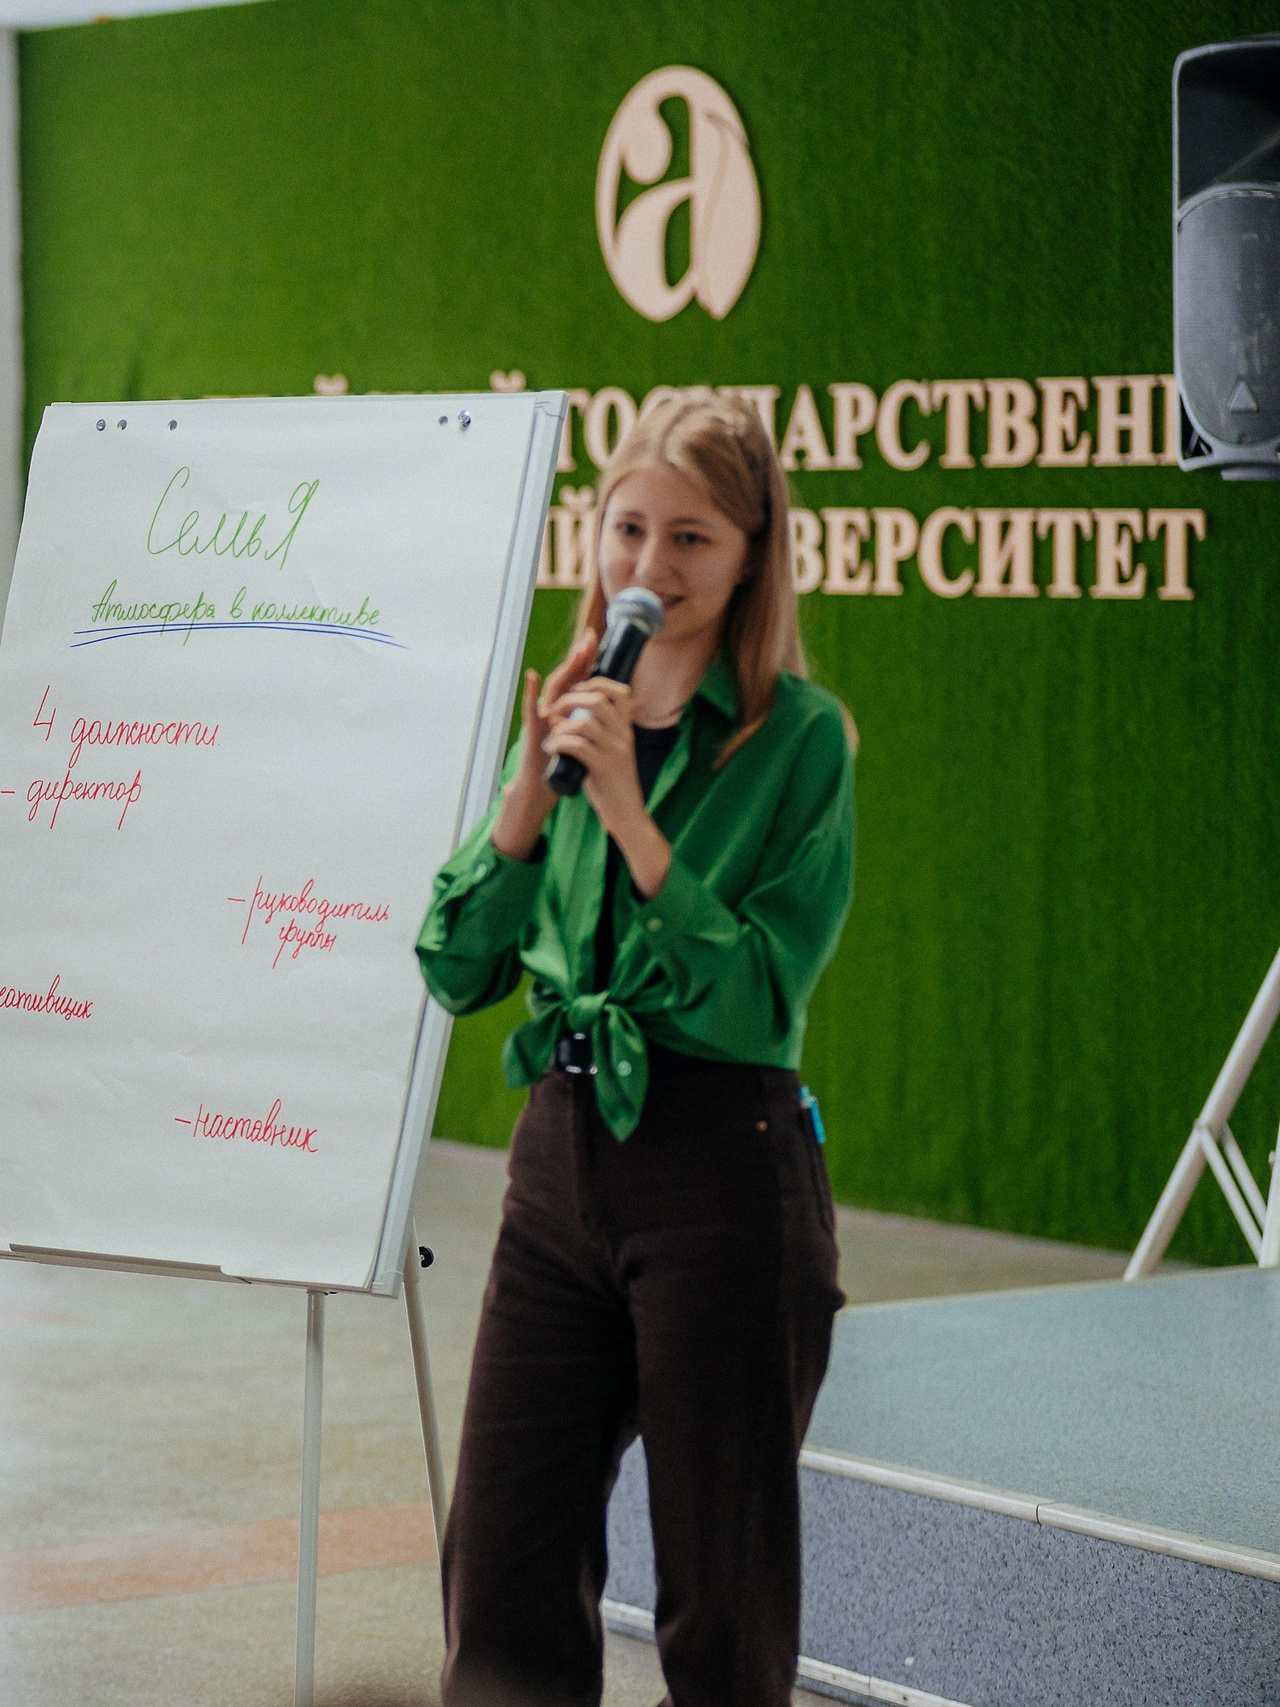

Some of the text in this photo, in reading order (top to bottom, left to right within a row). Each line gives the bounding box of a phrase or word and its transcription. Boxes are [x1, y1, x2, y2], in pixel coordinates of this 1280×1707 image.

[91, 579, 216, 646] Атмосфера
[230, 586, 246, 620] в
[33, 685, 56, 741] 4
